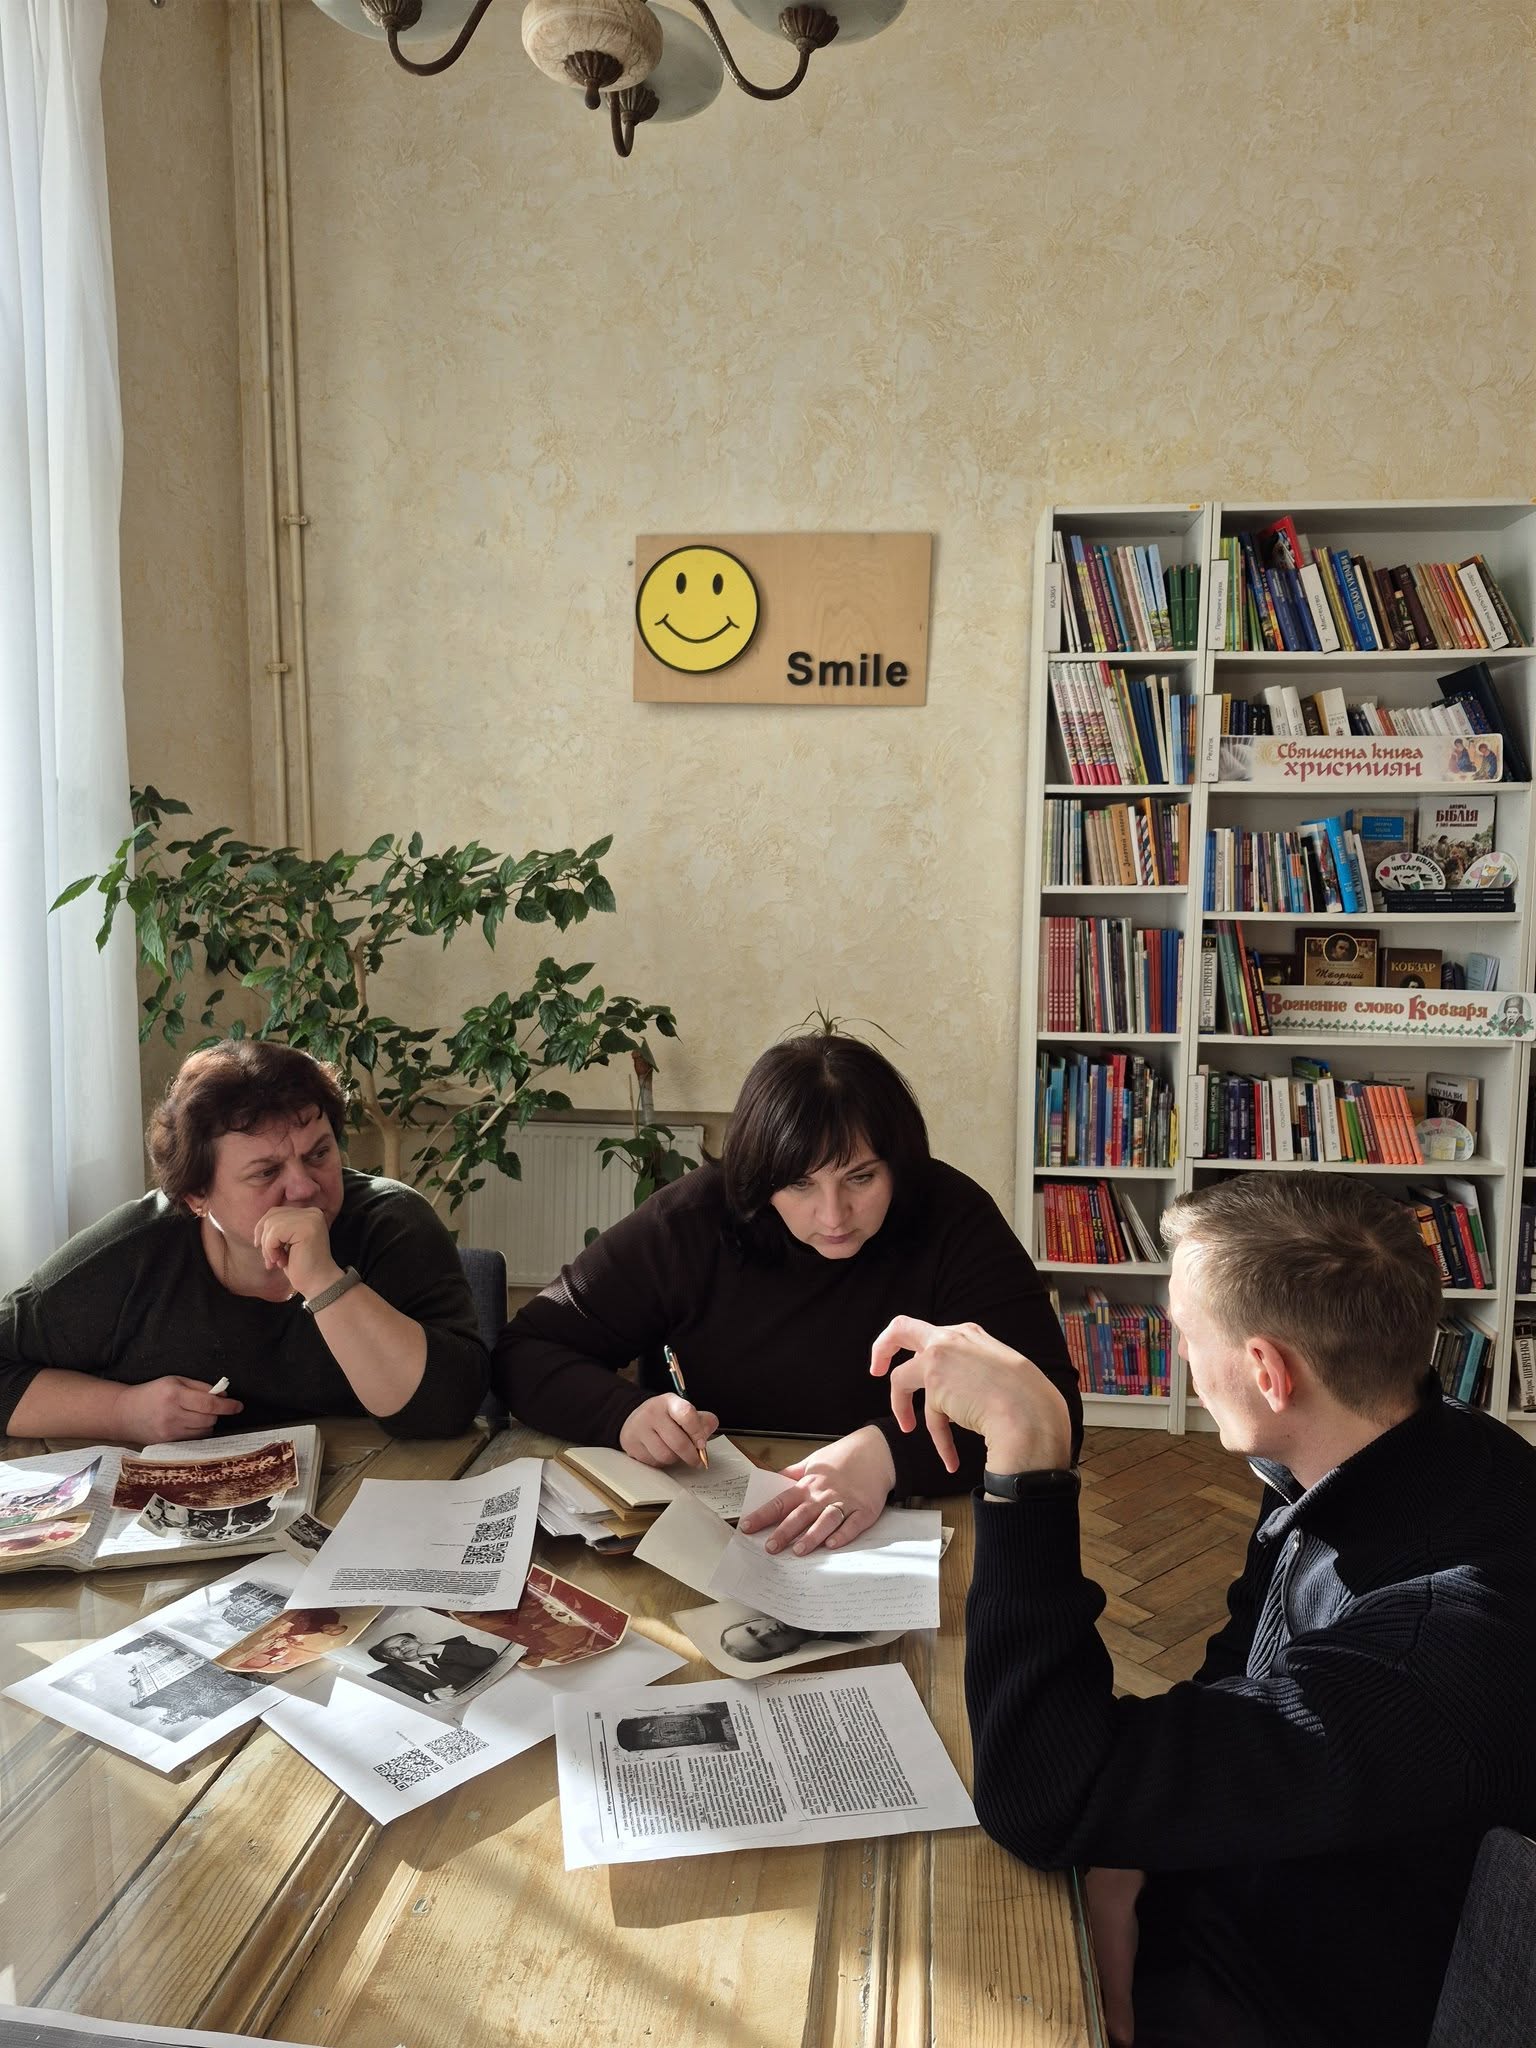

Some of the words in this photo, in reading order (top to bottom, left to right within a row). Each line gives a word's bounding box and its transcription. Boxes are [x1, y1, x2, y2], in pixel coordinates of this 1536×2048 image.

[786, 651, 908, 688] Smile
[1277, 742, 1367, 759] Священна
[1372, 743, 1423, 759] книга
[1284, 761, 1422, 782] християн
[1436, 809, 1479, 822] БІБЛІЯ
[1205, 938, 1212, 947] 6
[1202, 953, 1213, 996] ШЕВЧЕНКО
[1315, 968, 1364, 980] Творчий
[1391, 962, 1436, 973] КОБЗАР
[1268, 993, 1347, 1015] Вогненне
[1354, 1002, 1404, 1014] слово
[1408, 995, 1488, 1021] Кобзаря
[1443, 1089, 1453, 1098] НА
[1436, 1243, 1450, 1276] СЛОВНИК
[1519, 1340, 1533, 1379] ШЕВЧЕНКО
